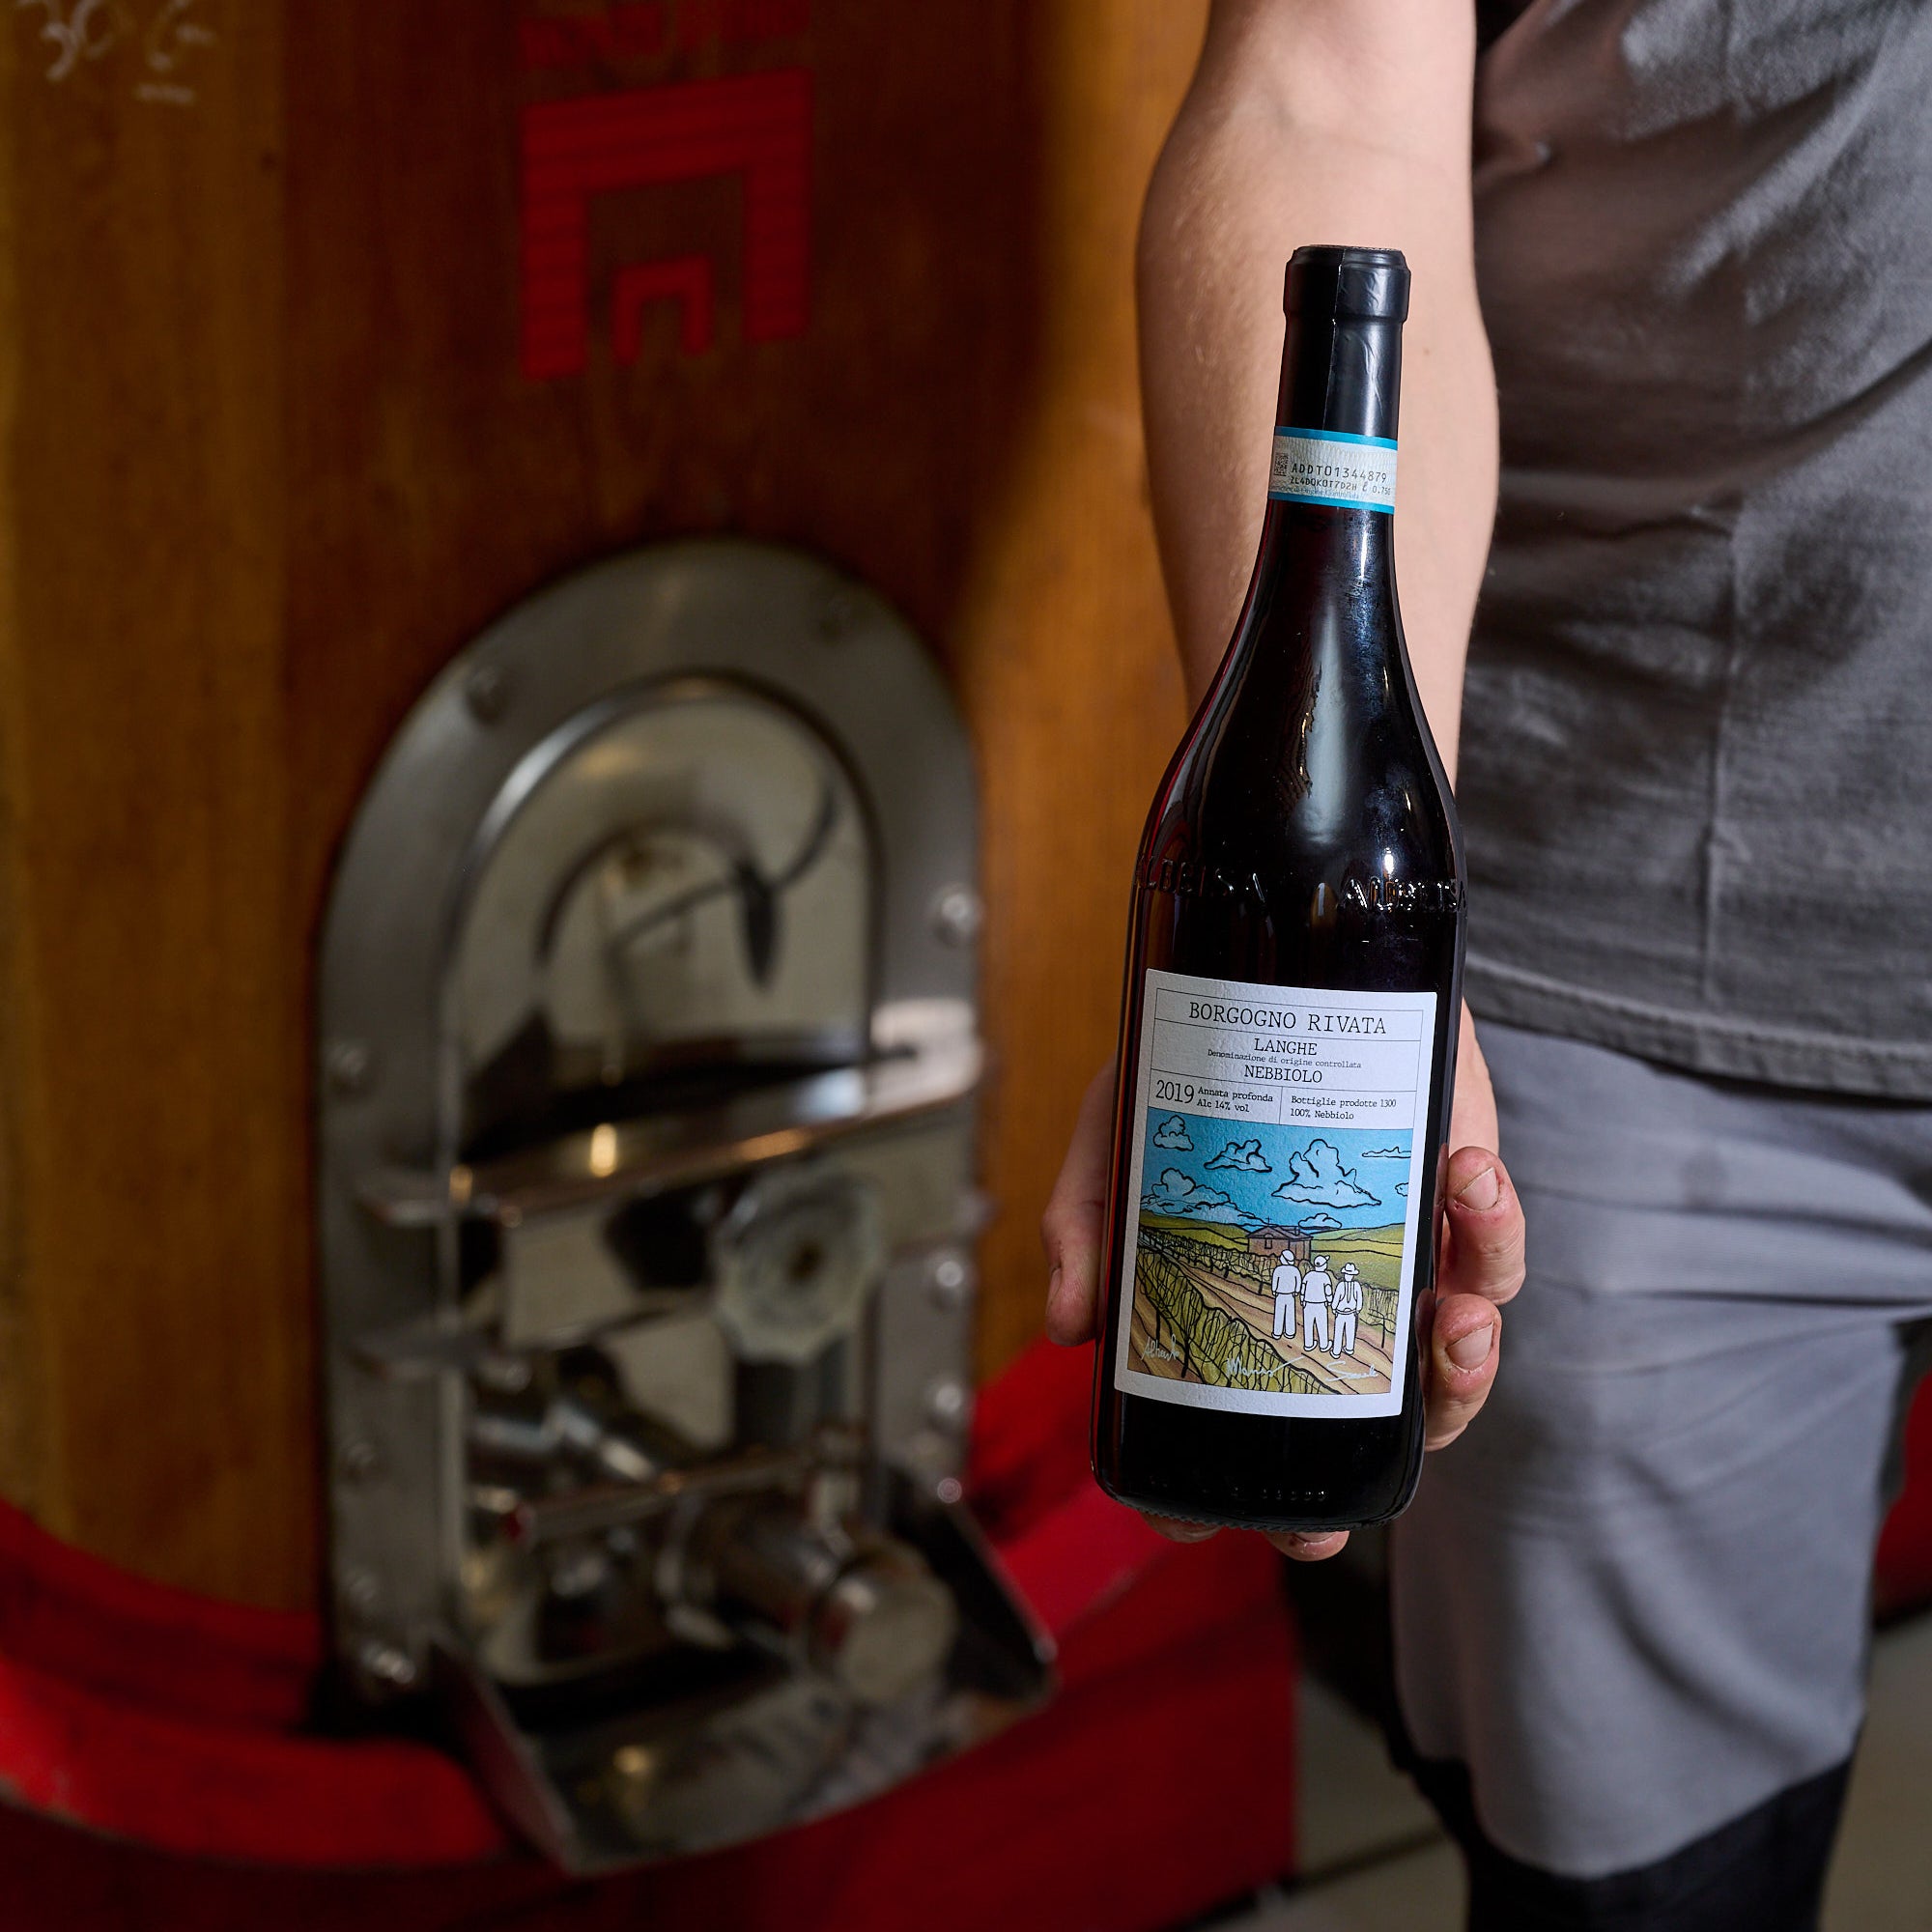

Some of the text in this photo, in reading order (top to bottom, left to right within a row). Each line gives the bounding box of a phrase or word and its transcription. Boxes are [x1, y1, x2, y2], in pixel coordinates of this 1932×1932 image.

[1188, 1001, 1387, 1035] BORGOGNO RIVATA
[1254, 1037, 1318, 1056] LANGHE
[1208, 1049, 1362, 1068] Denominazione di origine controllata
[1243, 1065, 1323, 1084] NEBBIOLO
[1155, 1079, 1194, 1104] 2019
[1197, 1087, 1274, 1102] Annata profonda
[1196, 1097, 1250, 1113] Alc 14% vol
[1291, 1095, 1397, 1110] Bottiglie prodotte 1300
[1290, 1108, 1354, 1121] 100% Nebbiolo
